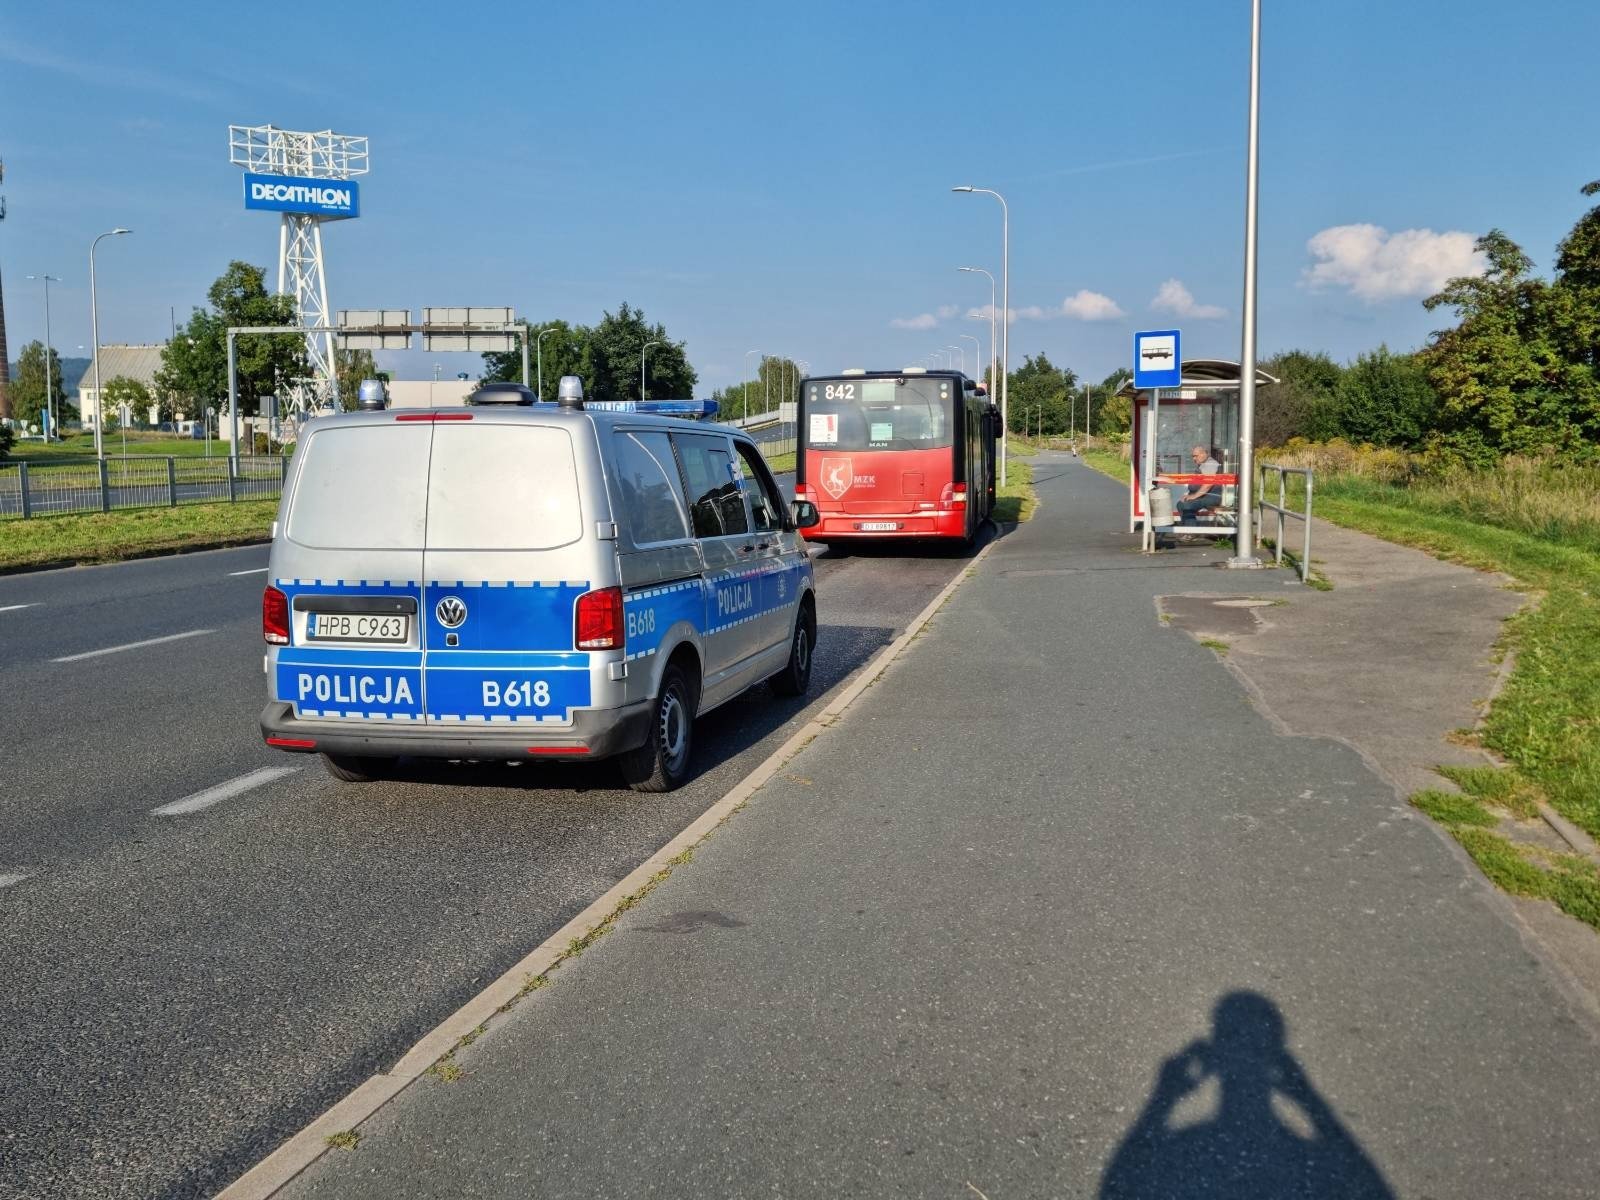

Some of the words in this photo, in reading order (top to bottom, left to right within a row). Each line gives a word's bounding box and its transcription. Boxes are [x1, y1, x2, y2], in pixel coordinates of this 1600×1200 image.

[251, 183, 351, 205] DECATHLON
[825, 384, 854, 400] 842
[853, 475, 876, 484] MZK
[718, 582, 753, 617] POLICJA
[318, 616, 351, 636] HPB
[357, 617, 401, 637] C963
[628, 607, 656, 638] B618
[298, 673, 414, 705] POLICJA
[482, 680, 551, 707] B618
